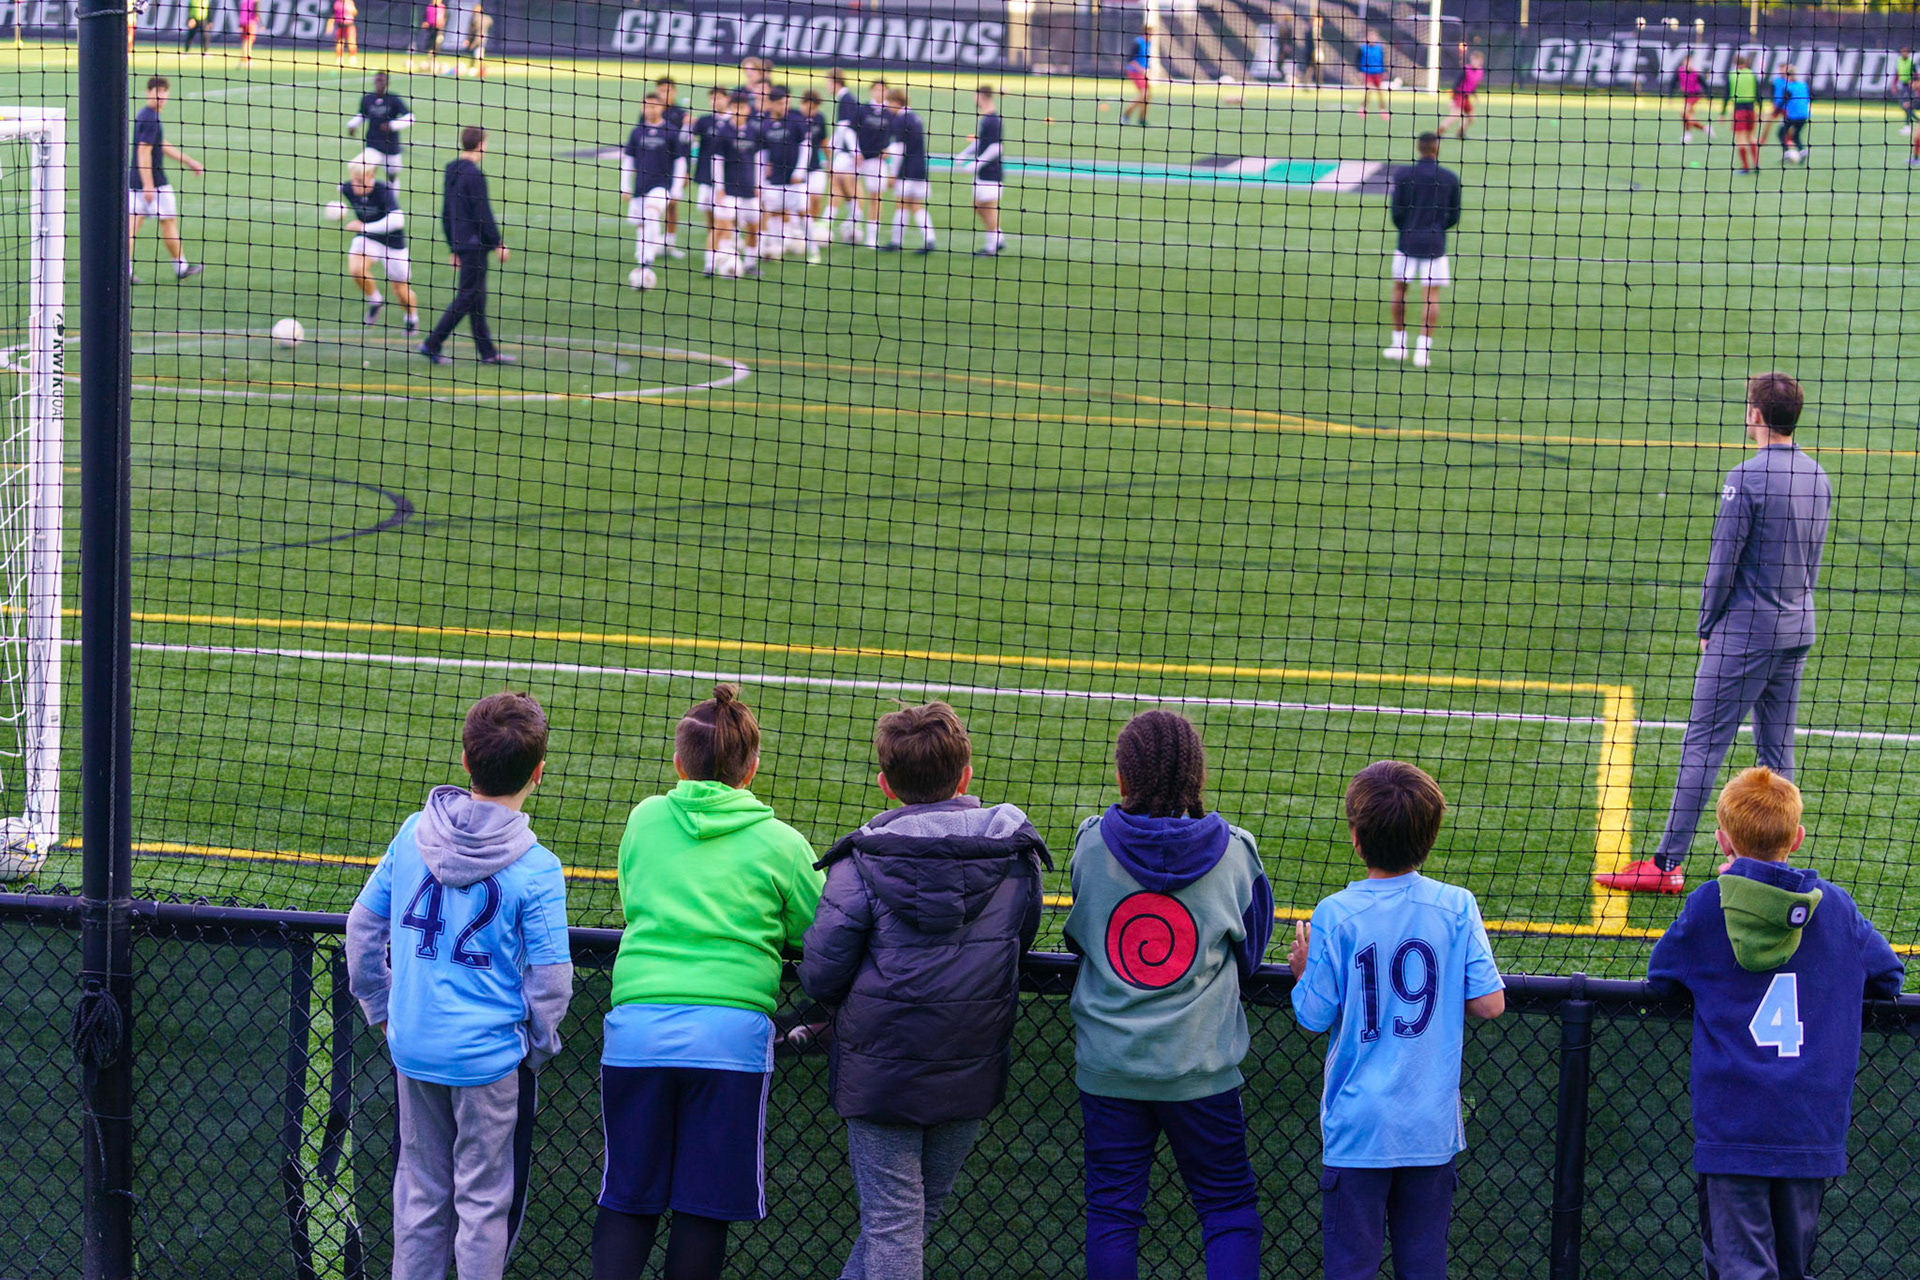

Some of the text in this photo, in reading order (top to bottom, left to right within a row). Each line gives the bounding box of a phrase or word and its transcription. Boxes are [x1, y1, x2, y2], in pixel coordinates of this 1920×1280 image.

[613, 9, 1003, 64] GREYHOUNDS
[1531, 38, 1920, 91] GREYHOUND
[400, 872, 503, 970] 42
[1355, 938, 1440, 1043] 19
[1748, 972, 1804, 1057] 4
